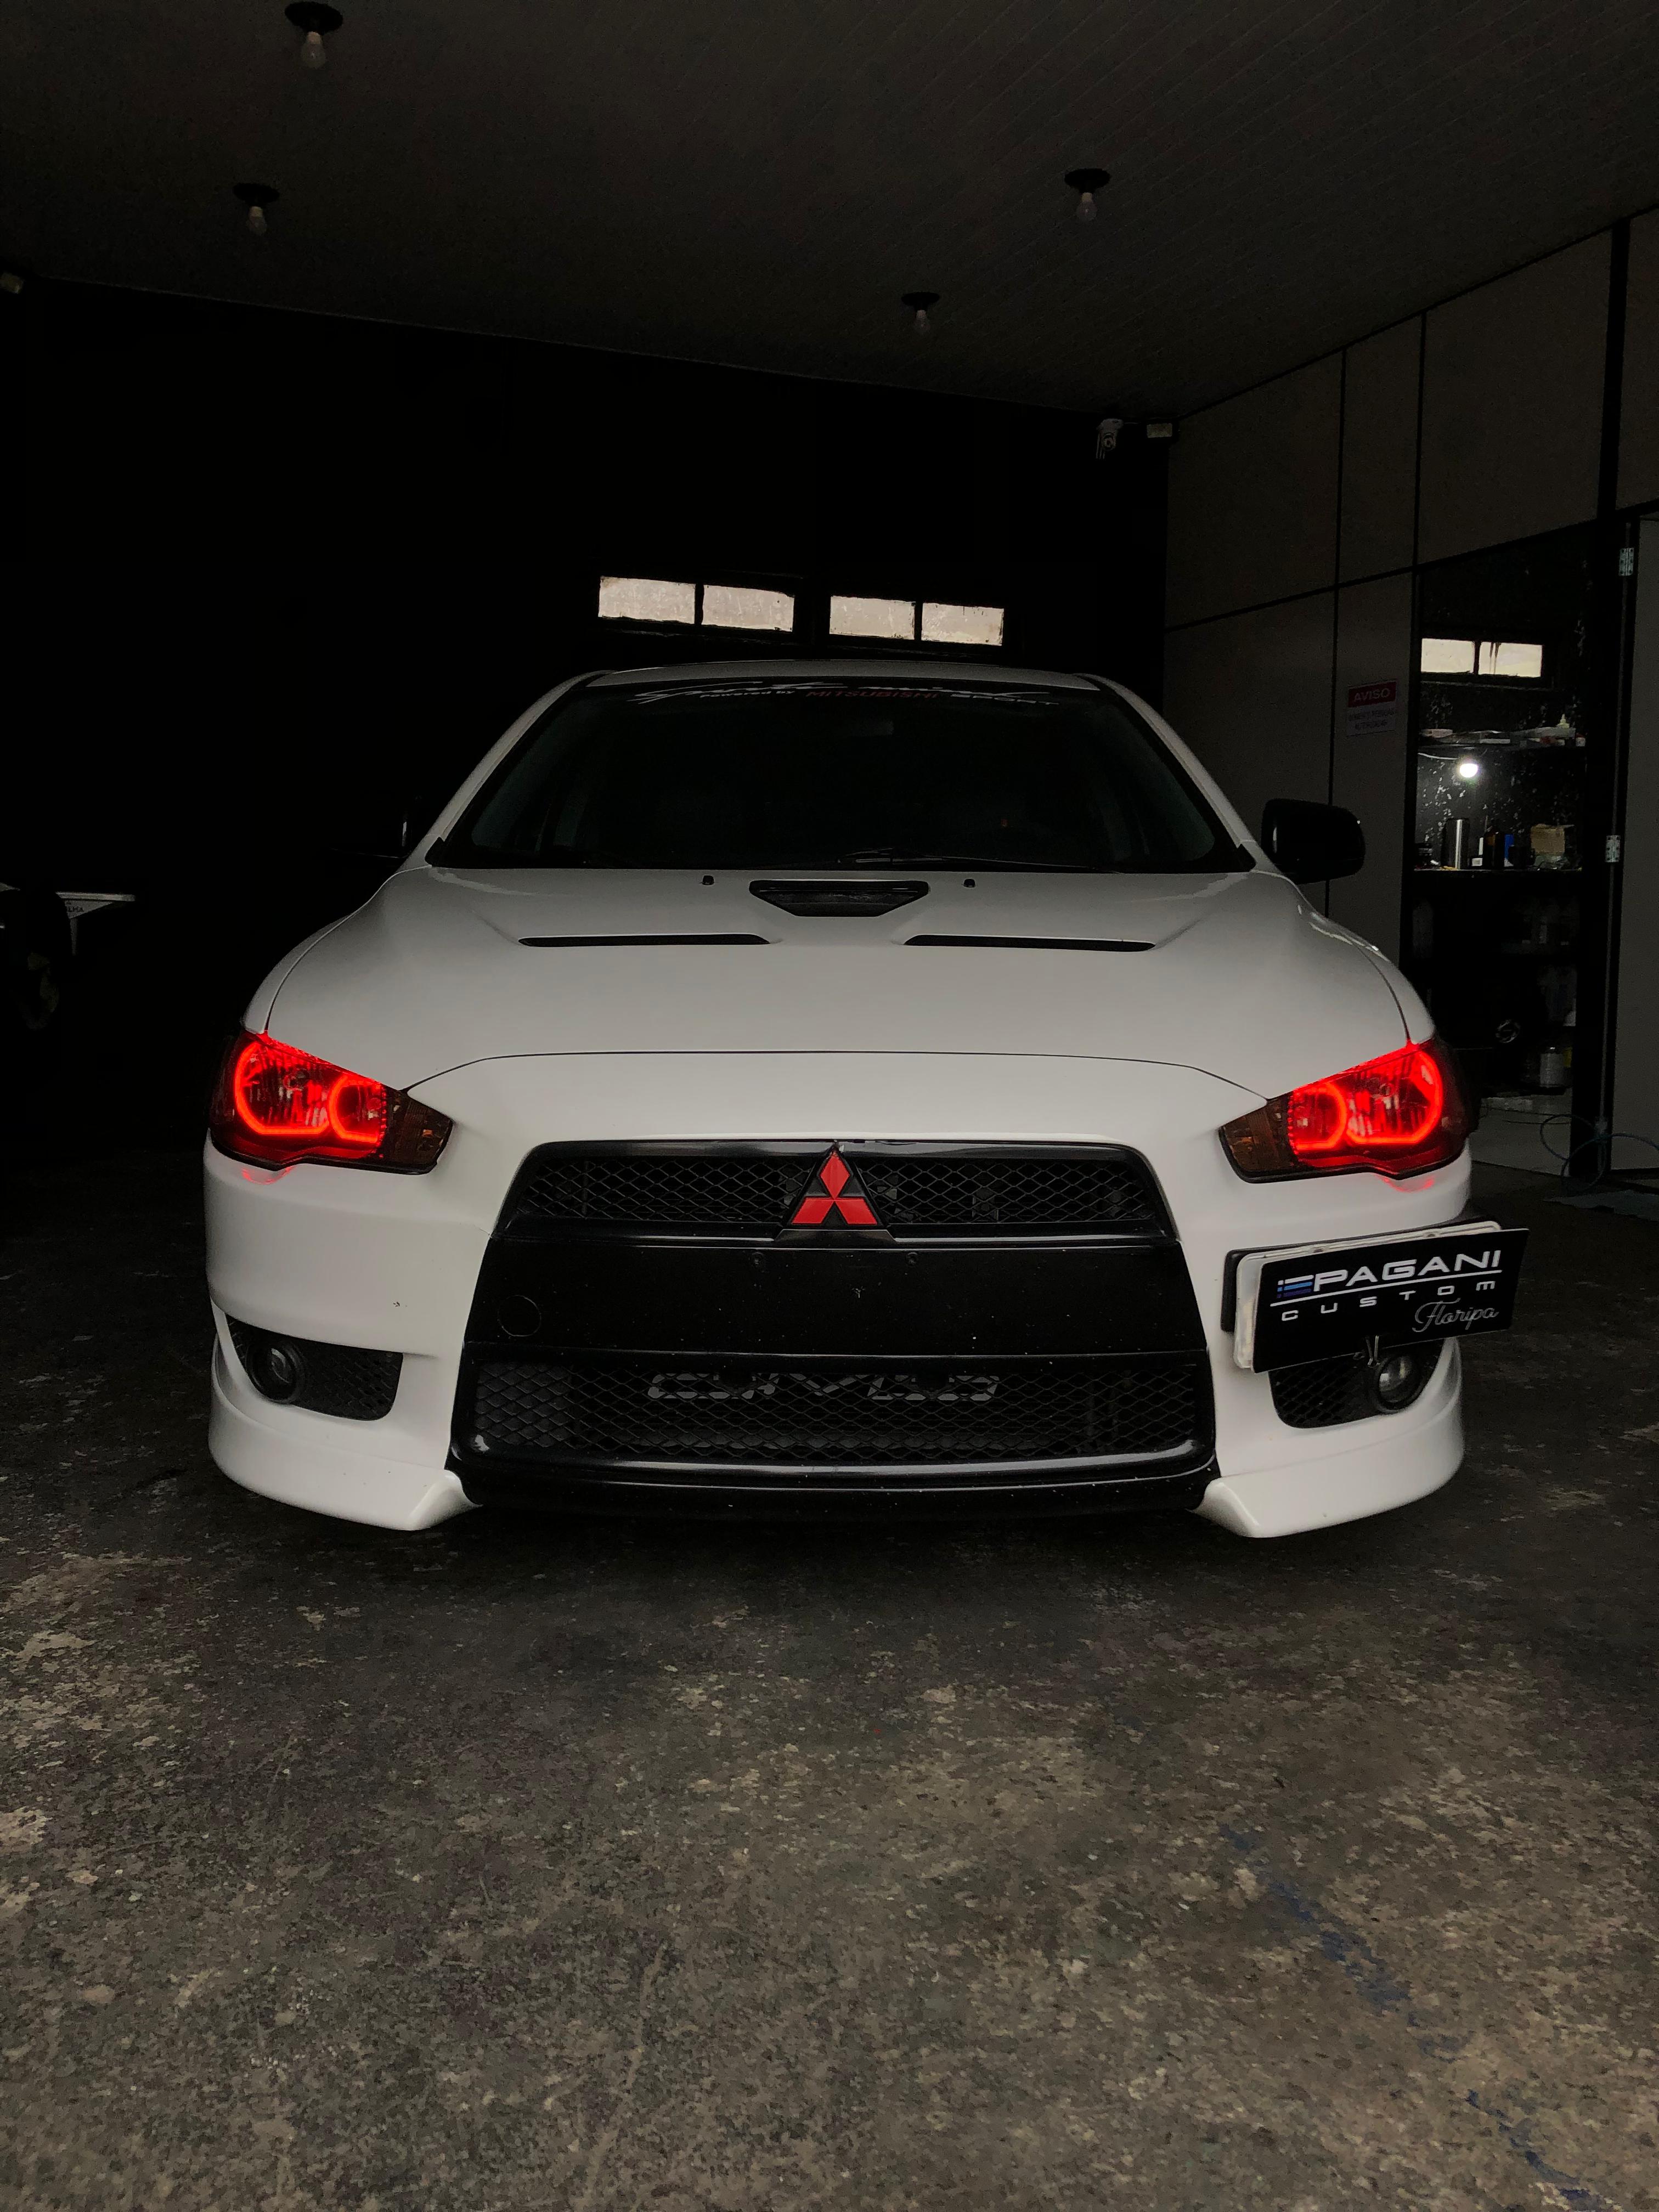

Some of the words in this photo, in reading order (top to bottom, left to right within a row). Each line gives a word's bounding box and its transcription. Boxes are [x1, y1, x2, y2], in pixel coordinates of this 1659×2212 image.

[1353, 687, 1391, 702] AVISO
[1313, 1250, 1502, 1291] PAGANI
[1281, 1280, 1496, 1321] CUSTOM
[1412, 1297, 1499, 1333] Floripa
